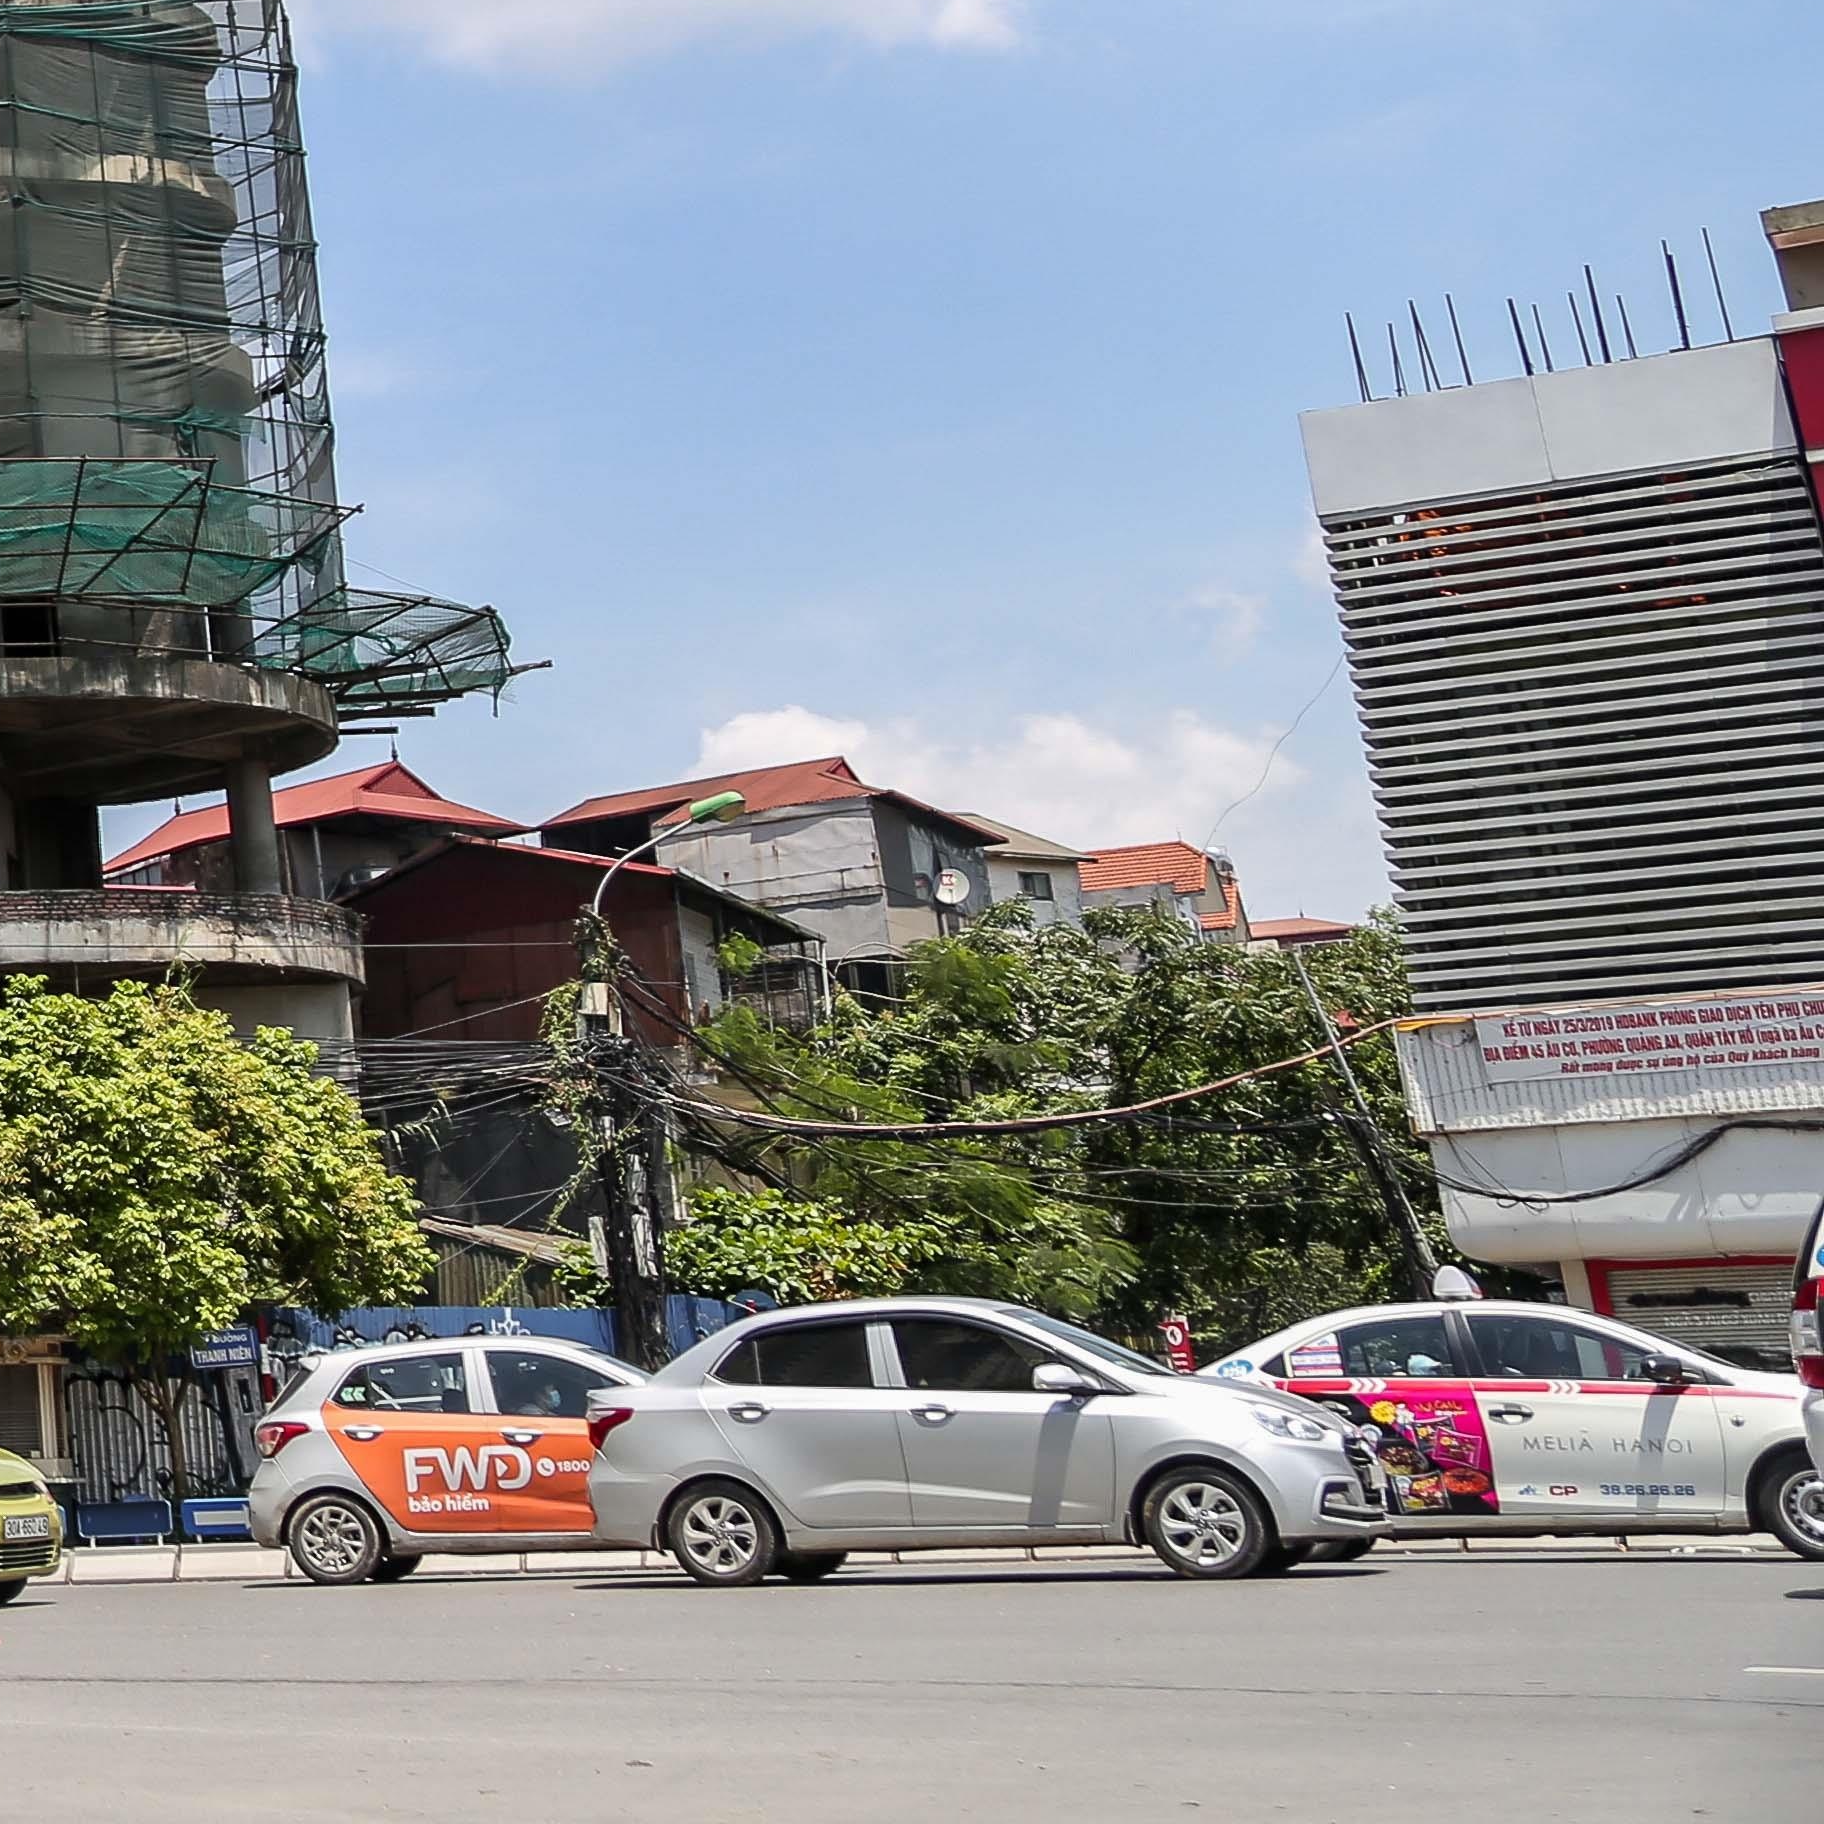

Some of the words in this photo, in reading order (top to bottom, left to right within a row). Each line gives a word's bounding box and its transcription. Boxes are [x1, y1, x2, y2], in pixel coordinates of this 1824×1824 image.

[1563, 1014, 1614, 1034] 25/3/2019
[1660, 1007, 1696, 1027] PHÒNG
[1698, 1007, 1724, 1025] GIAO
[1725, 1004, 1752, 1025] DỊCH
[1753, 1001, 1776, 1019] YÊN
[1776, 1001, 1801, 1020] PHỤ
[1531, 1043, 1545, 1058] 45
[1581, 1035, 1624, 1056] PHƯỜNG
[1685, 1028, 1715, 1050] QUẬN
[1716, 1027, 1738, 1046] TÂY
[1782, 1027, 1798, 1040] ba
[1816, 1023, 1824, 1038] C
[1582, 1061, 1613, 1073] mong
[1753, 1047, 1788, 1061] khách
[1790, 1045, 1820, 1059] hàng
[1612, 1437, 1693, 1454] HANOI
[403, 1445, 532, 1493] FWD
[556, 1459, 591, 1472] 1800
[1549, 1485, 1578, 1496] CP
[1600, 1483, 1696, 1496] 38.26.26.26
[408, 1496, 442, 1512] bảo
[445, 1493, 490, 1512] hiểm
